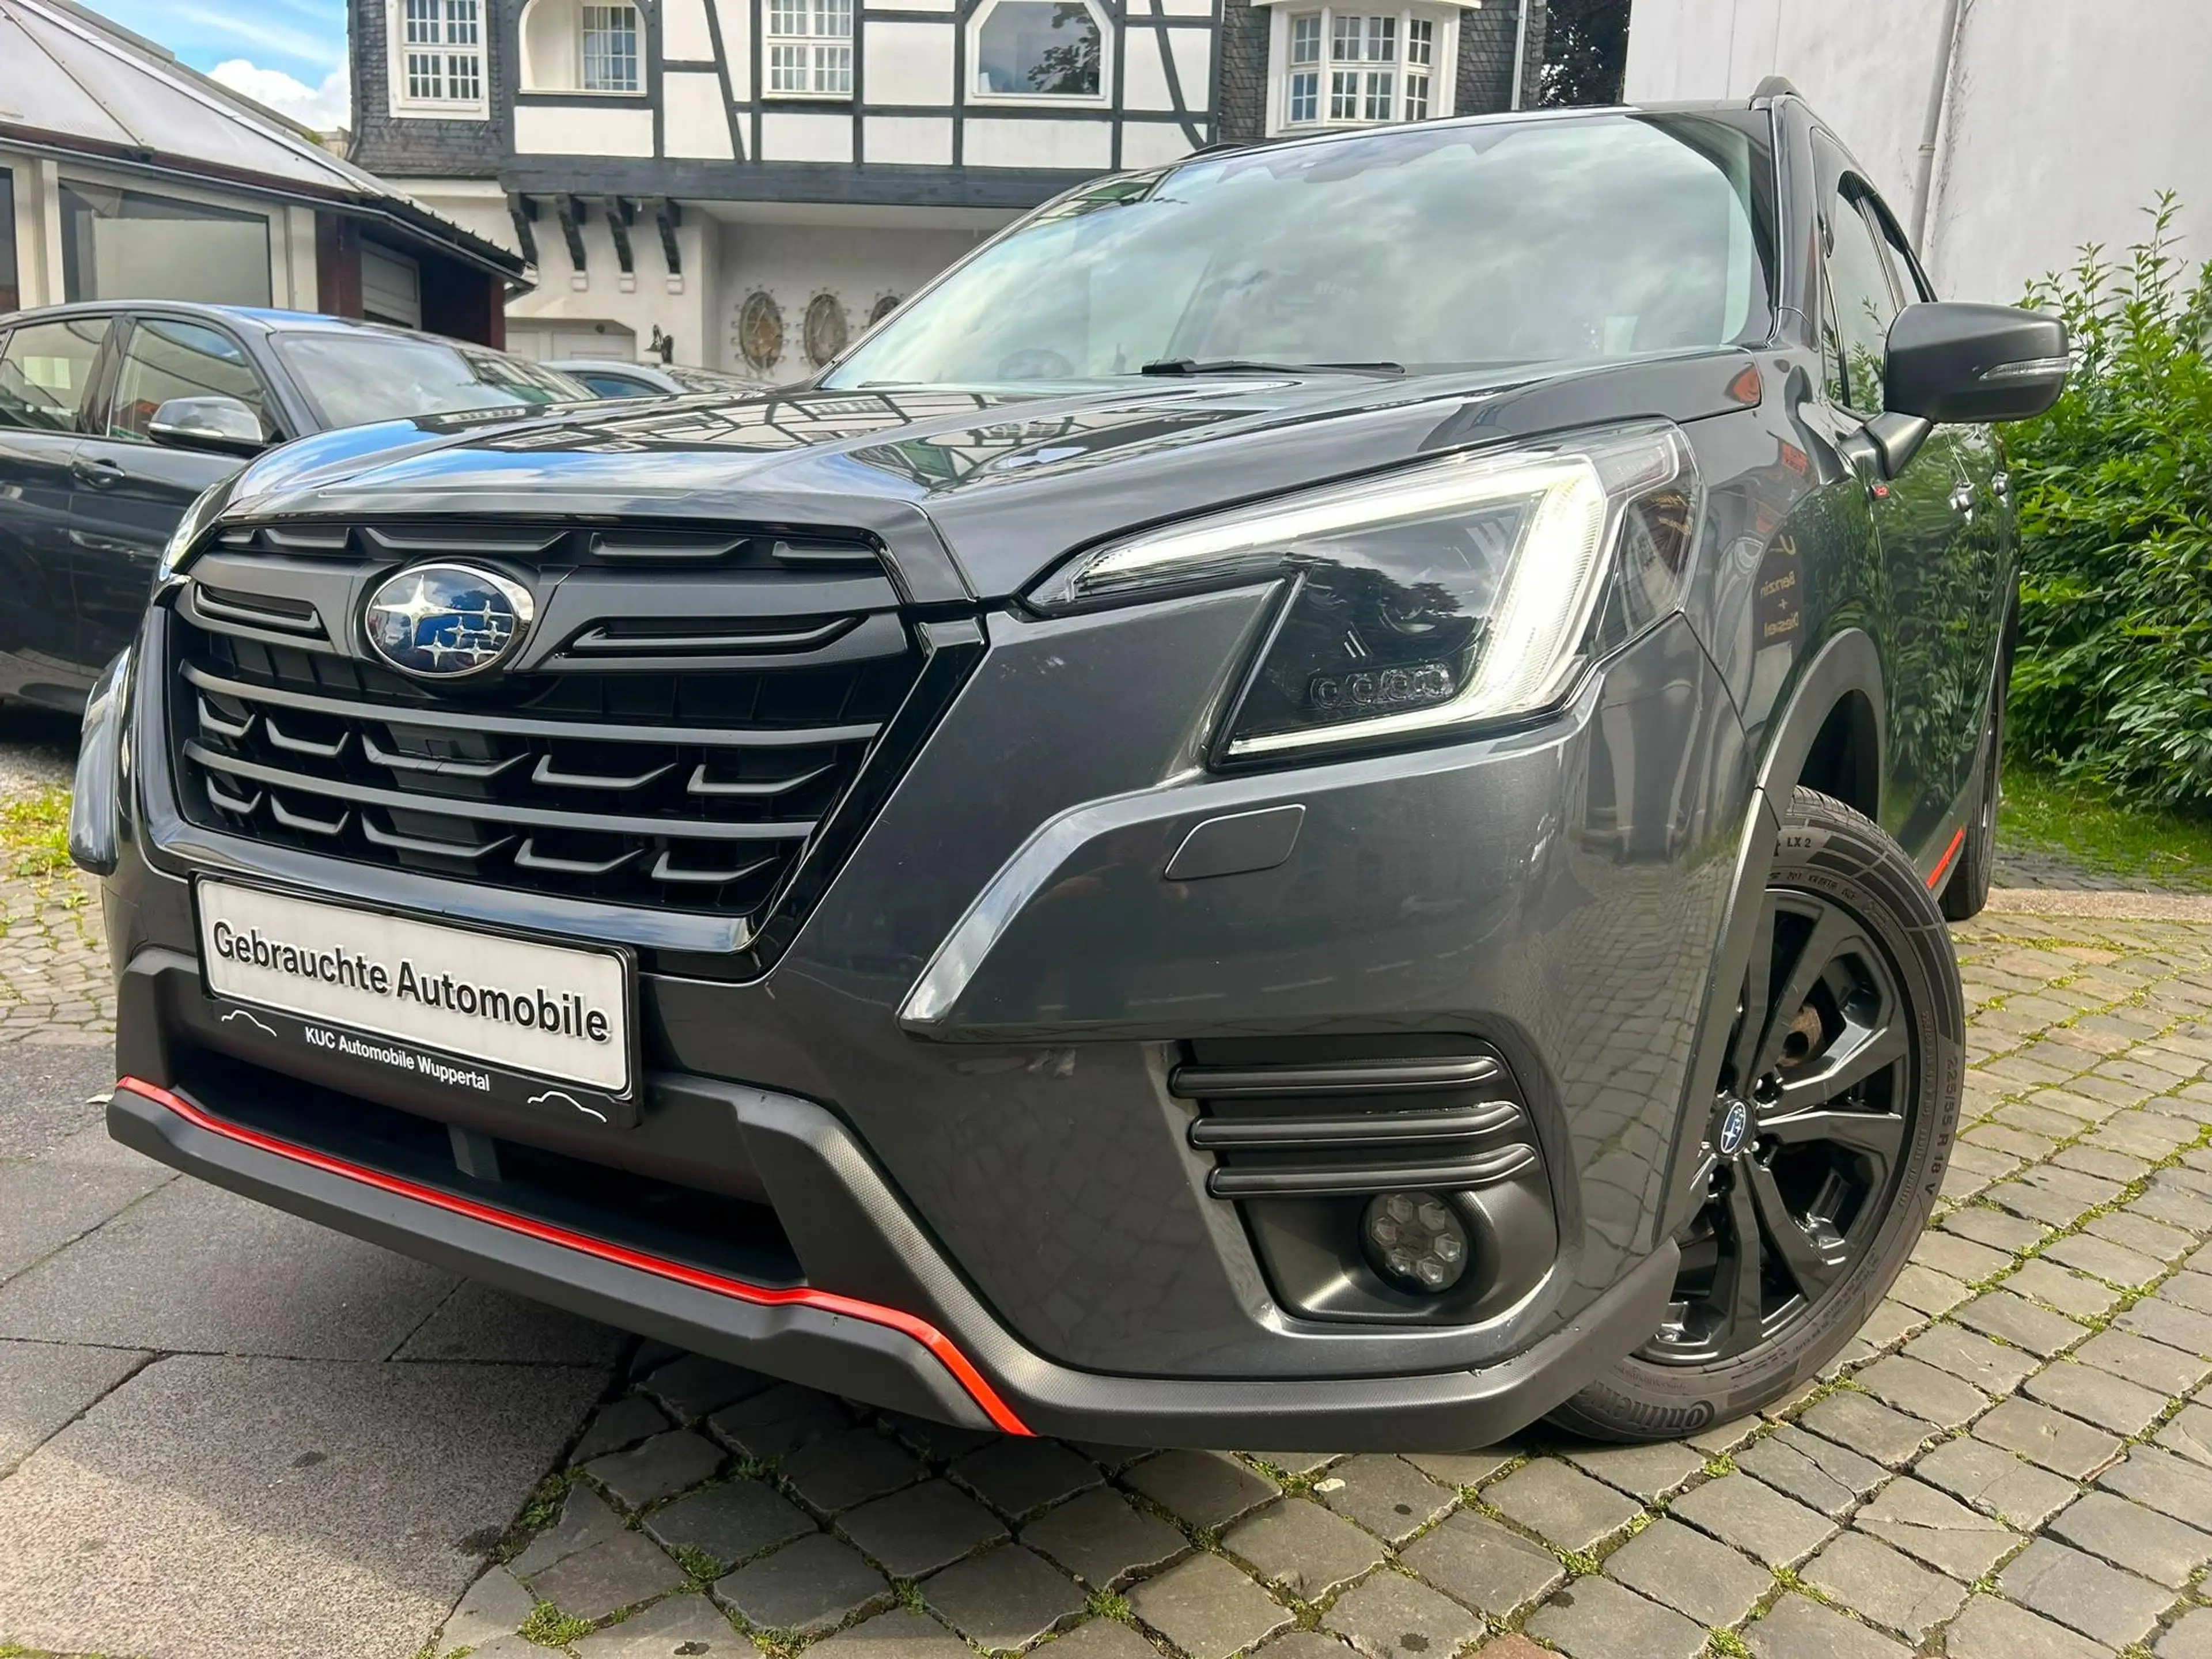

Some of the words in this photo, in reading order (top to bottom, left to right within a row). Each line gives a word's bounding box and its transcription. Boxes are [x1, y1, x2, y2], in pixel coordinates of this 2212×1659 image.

[213, 921, 388, 994] Gebrauchte
[396, 961, 608, 1042] Automobile
[305, 1026, 335, 1049] KUC
[339, 1035, 415, 1070] Automobile
[416, 1054, 490, 1092] Wuppertal
[1930, 1155, 1945, 1174] 18
